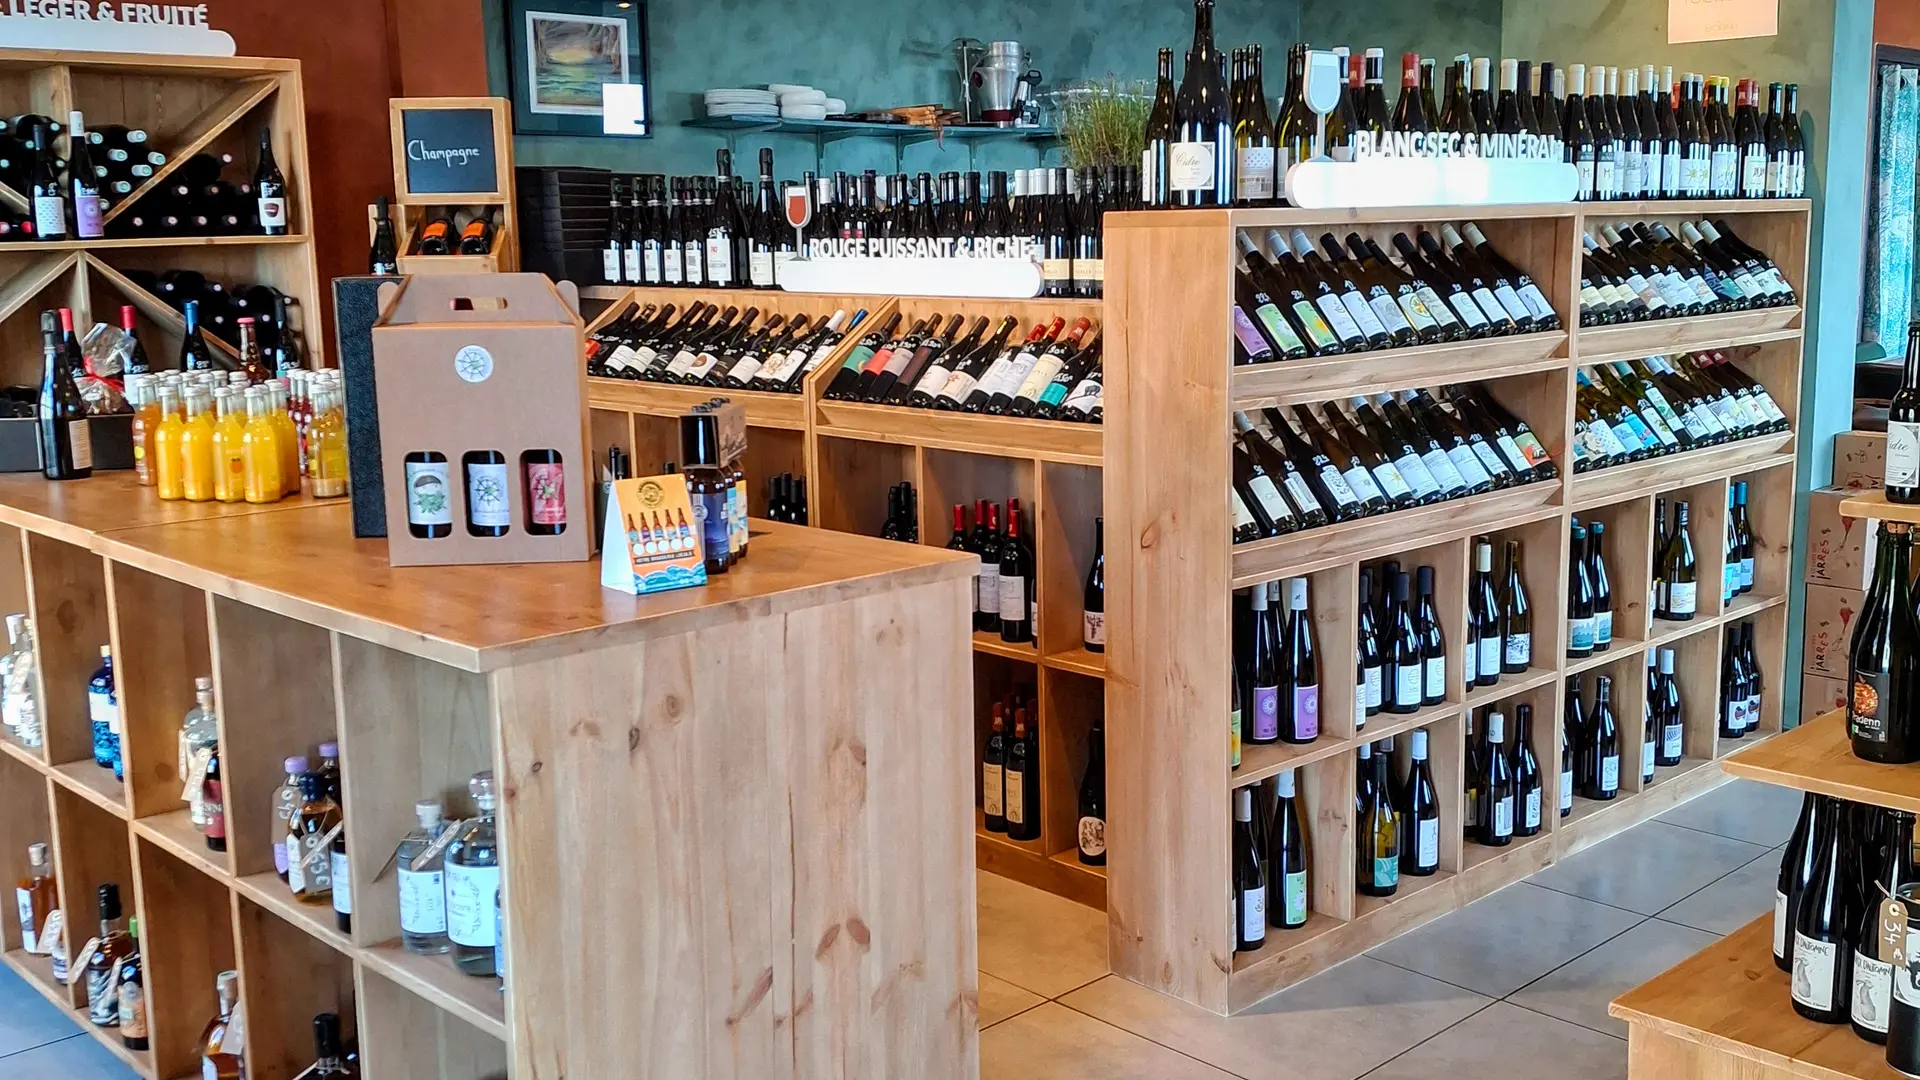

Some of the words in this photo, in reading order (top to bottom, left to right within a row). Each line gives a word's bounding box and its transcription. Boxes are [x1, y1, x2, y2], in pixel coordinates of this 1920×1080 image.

[97, 3, 116, 22] &
[122, 3, 208, 27] FRUITÉ
[407, 139, 480, 168] Champagne
[1355, 129, 1424, 159] BLANC
[1424, 130, 1461, 159] SEC
[1462, 132, 1479, 158] &
[1480, 128, 1559, 159] MINÉRAL
[809, 237, 868, 258] ROUGE
[868, 236, 955, 259] PUISSANT
[954, 237, 976, 258] &
[977, 234, 1036, 259] RICHE
